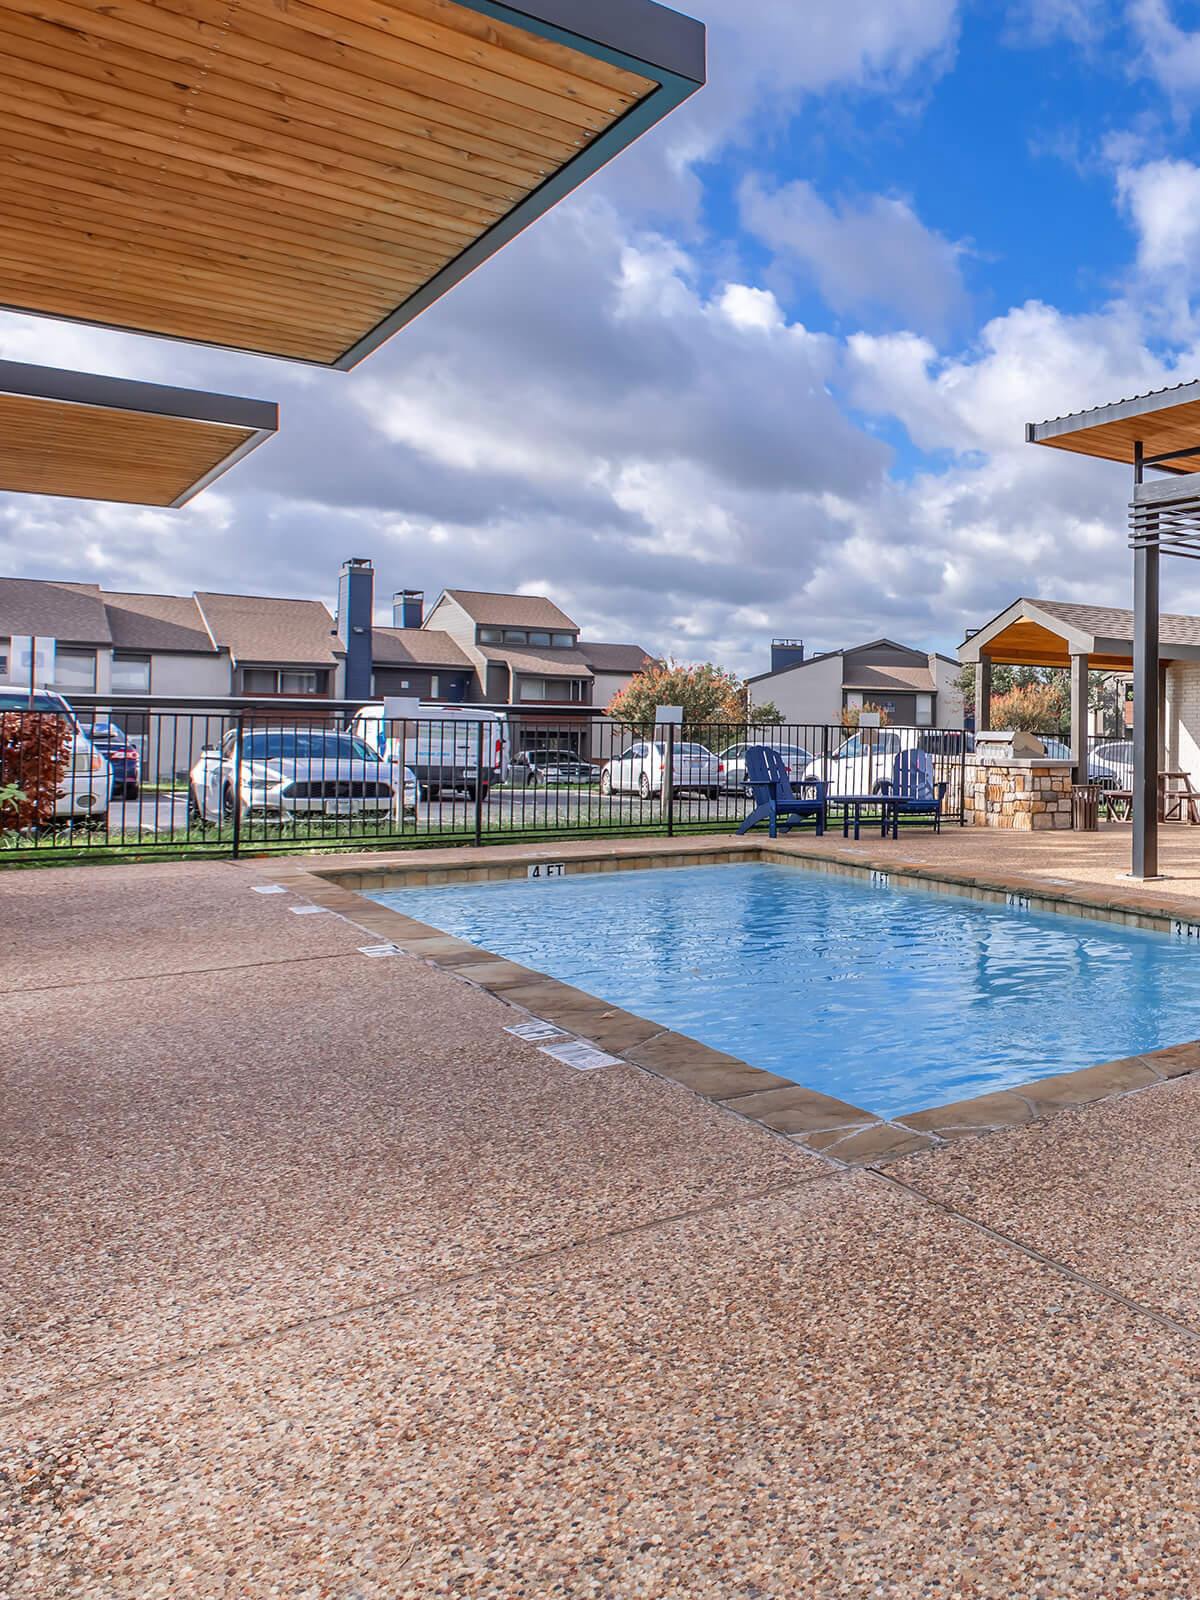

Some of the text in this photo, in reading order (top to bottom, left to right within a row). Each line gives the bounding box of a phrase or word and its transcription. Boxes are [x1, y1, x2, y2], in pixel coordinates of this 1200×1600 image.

[532, 864, 564, 877] 4 FT
[1175, 921, 1182, 936] 3
